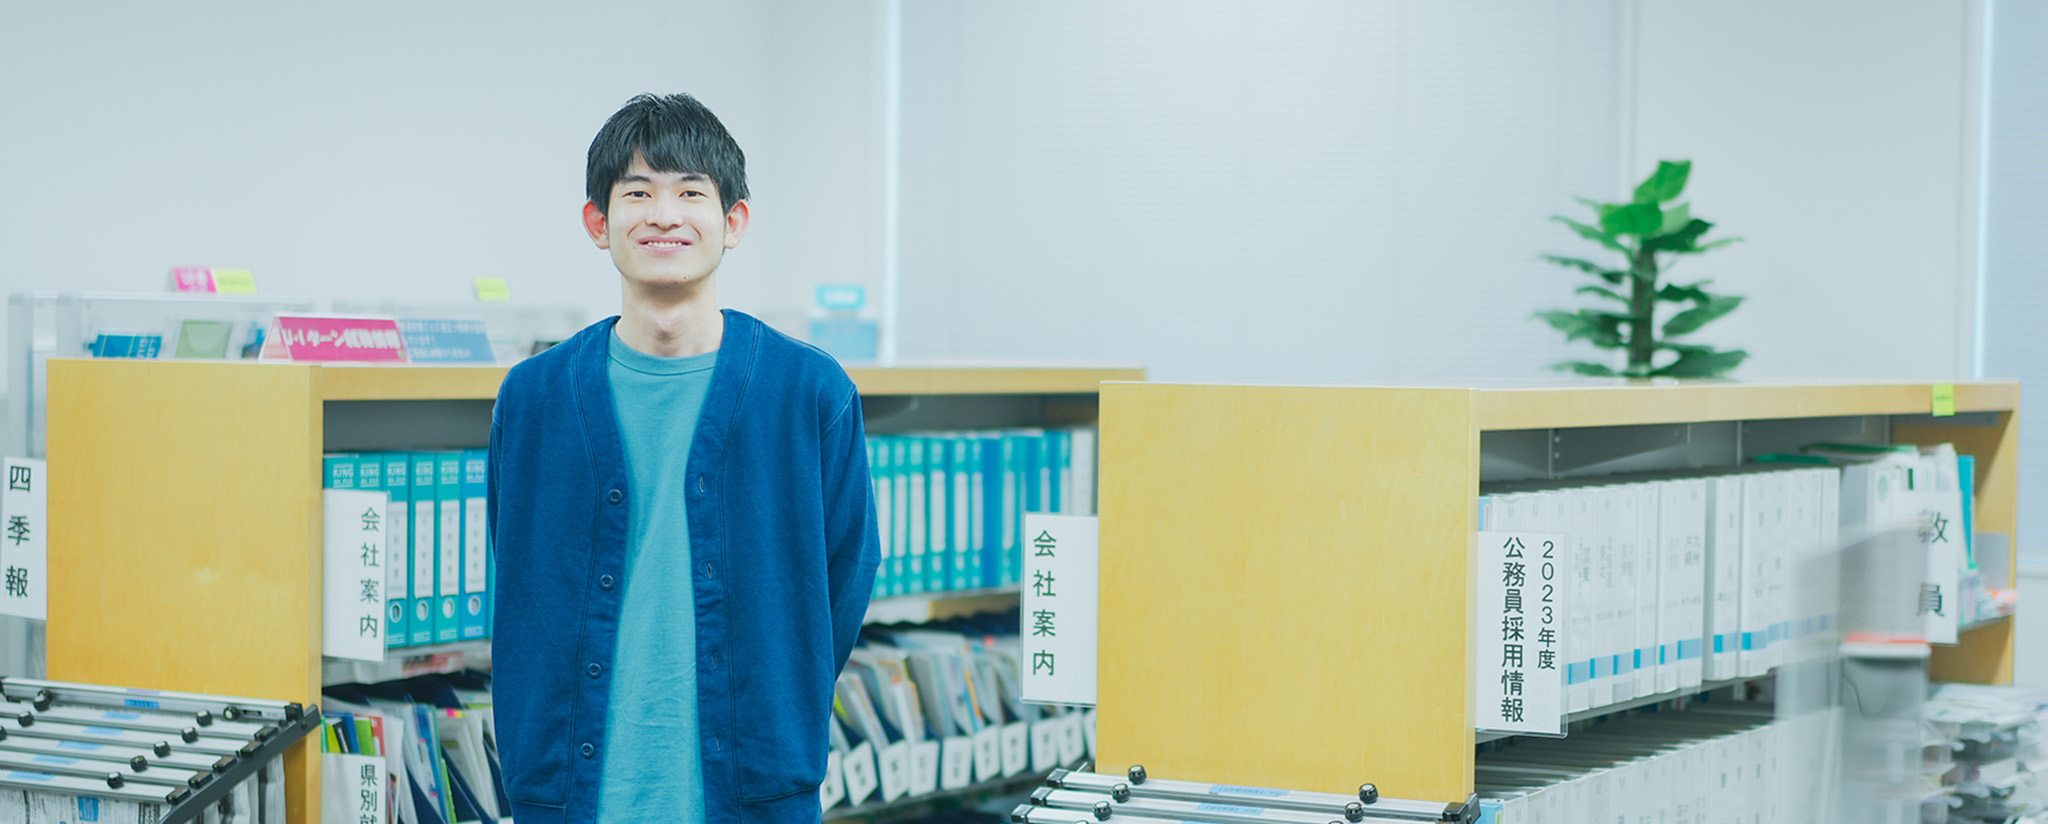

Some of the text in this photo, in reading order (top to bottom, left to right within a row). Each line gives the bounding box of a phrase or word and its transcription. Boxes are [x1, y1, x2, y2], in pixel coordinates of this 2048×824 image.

[5, 465, 32, 598] 四季報
[360, 507, 380, 638] 会社案内
[1033, 529, 1057, 676] 会社案内
[1500, 536, 1526, 723] 公務員採用情報
[1537, 540, 1556, 670] 2023年度
